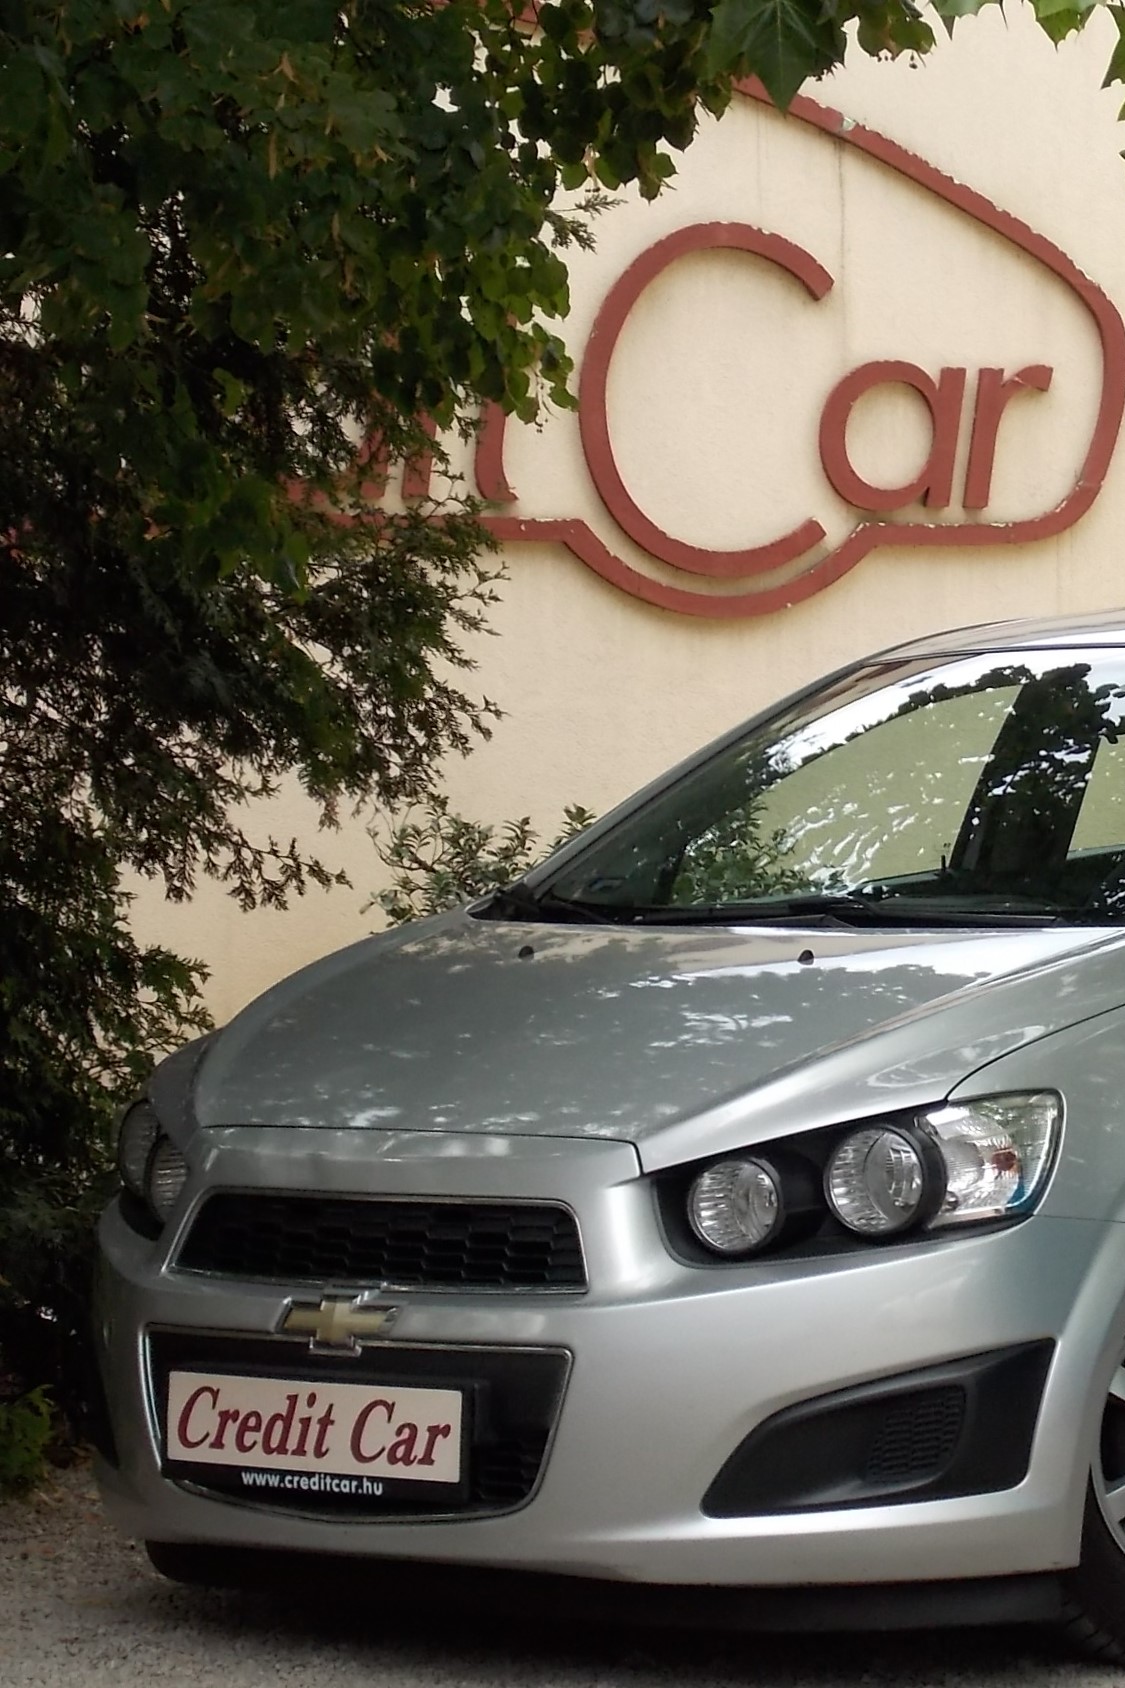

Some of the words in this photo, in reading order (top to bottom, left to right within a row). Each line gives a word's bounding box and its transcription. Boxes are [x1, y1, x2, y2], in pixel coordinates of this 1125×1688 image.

[580, 220, 1054, 578] Car
[177, 1386, 335, 1459] Credit
[350, 1399, 451, 1466] Car
[241, 1471, 383, 1496] www.creditcar.hu
